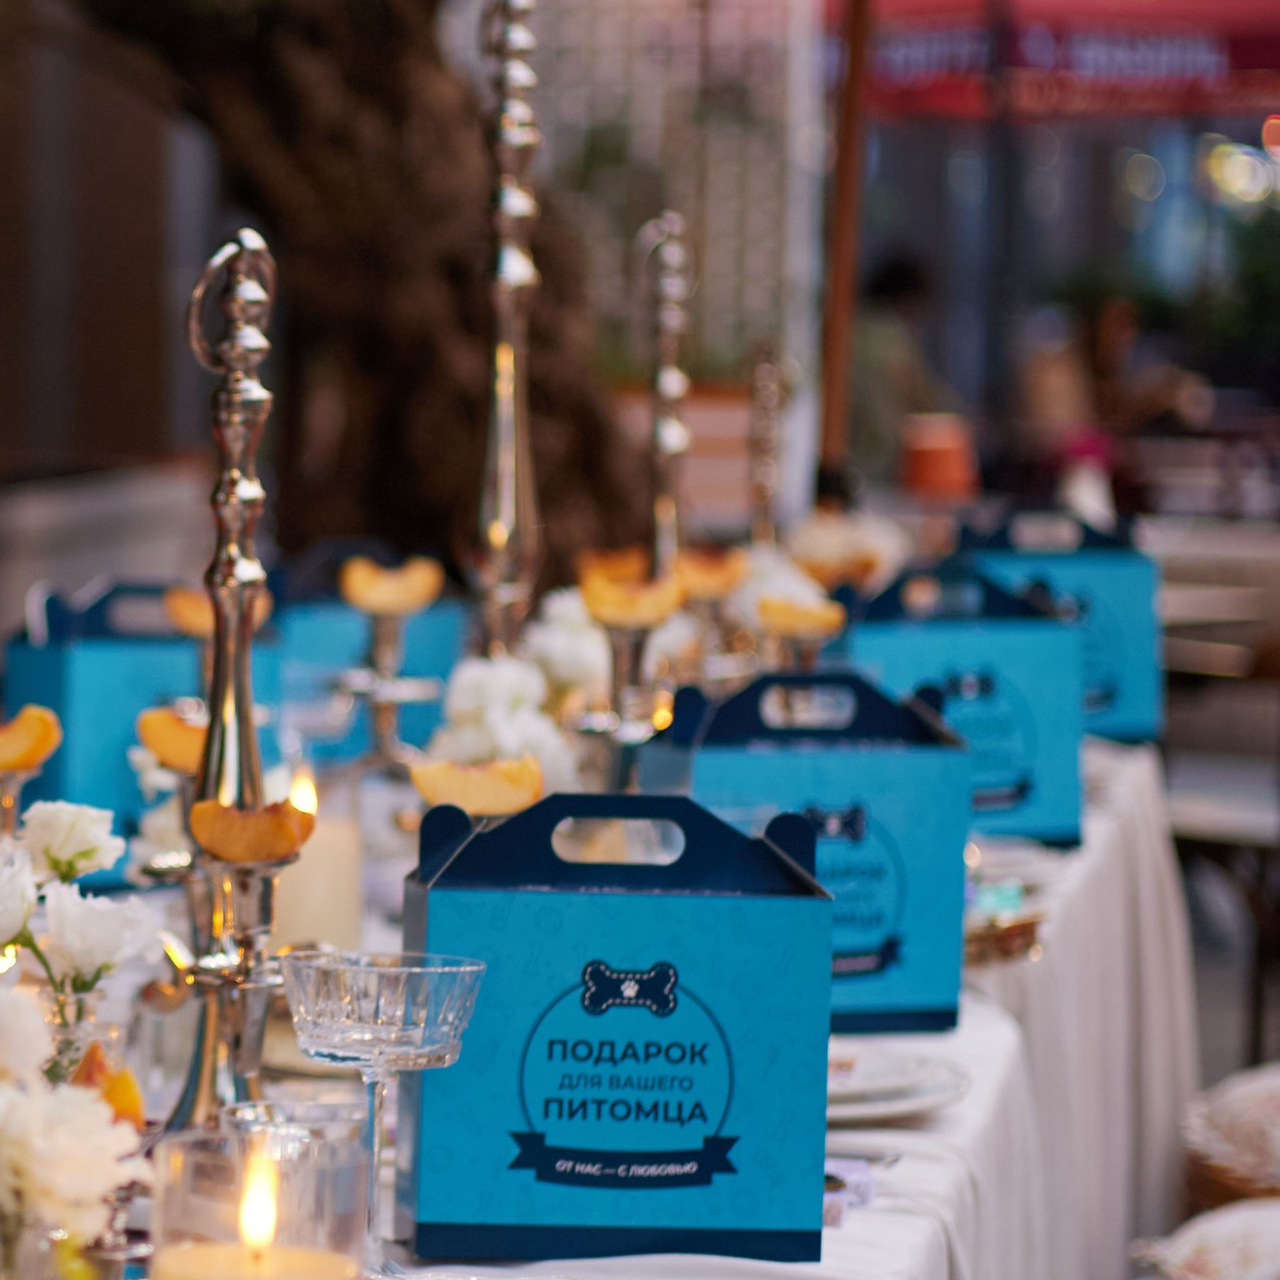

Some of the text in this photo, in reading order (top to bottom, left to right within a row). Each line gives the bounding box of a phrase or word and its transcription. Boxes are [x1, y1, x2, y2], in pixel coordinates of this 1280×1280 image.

[547, 1039, 708, 1066] ПОДАРОК
[558, 1073, 695, 1093] ДЛЯ ВАШЕГО
[544, 1098, 708, 1127] ПИТОМЦА
